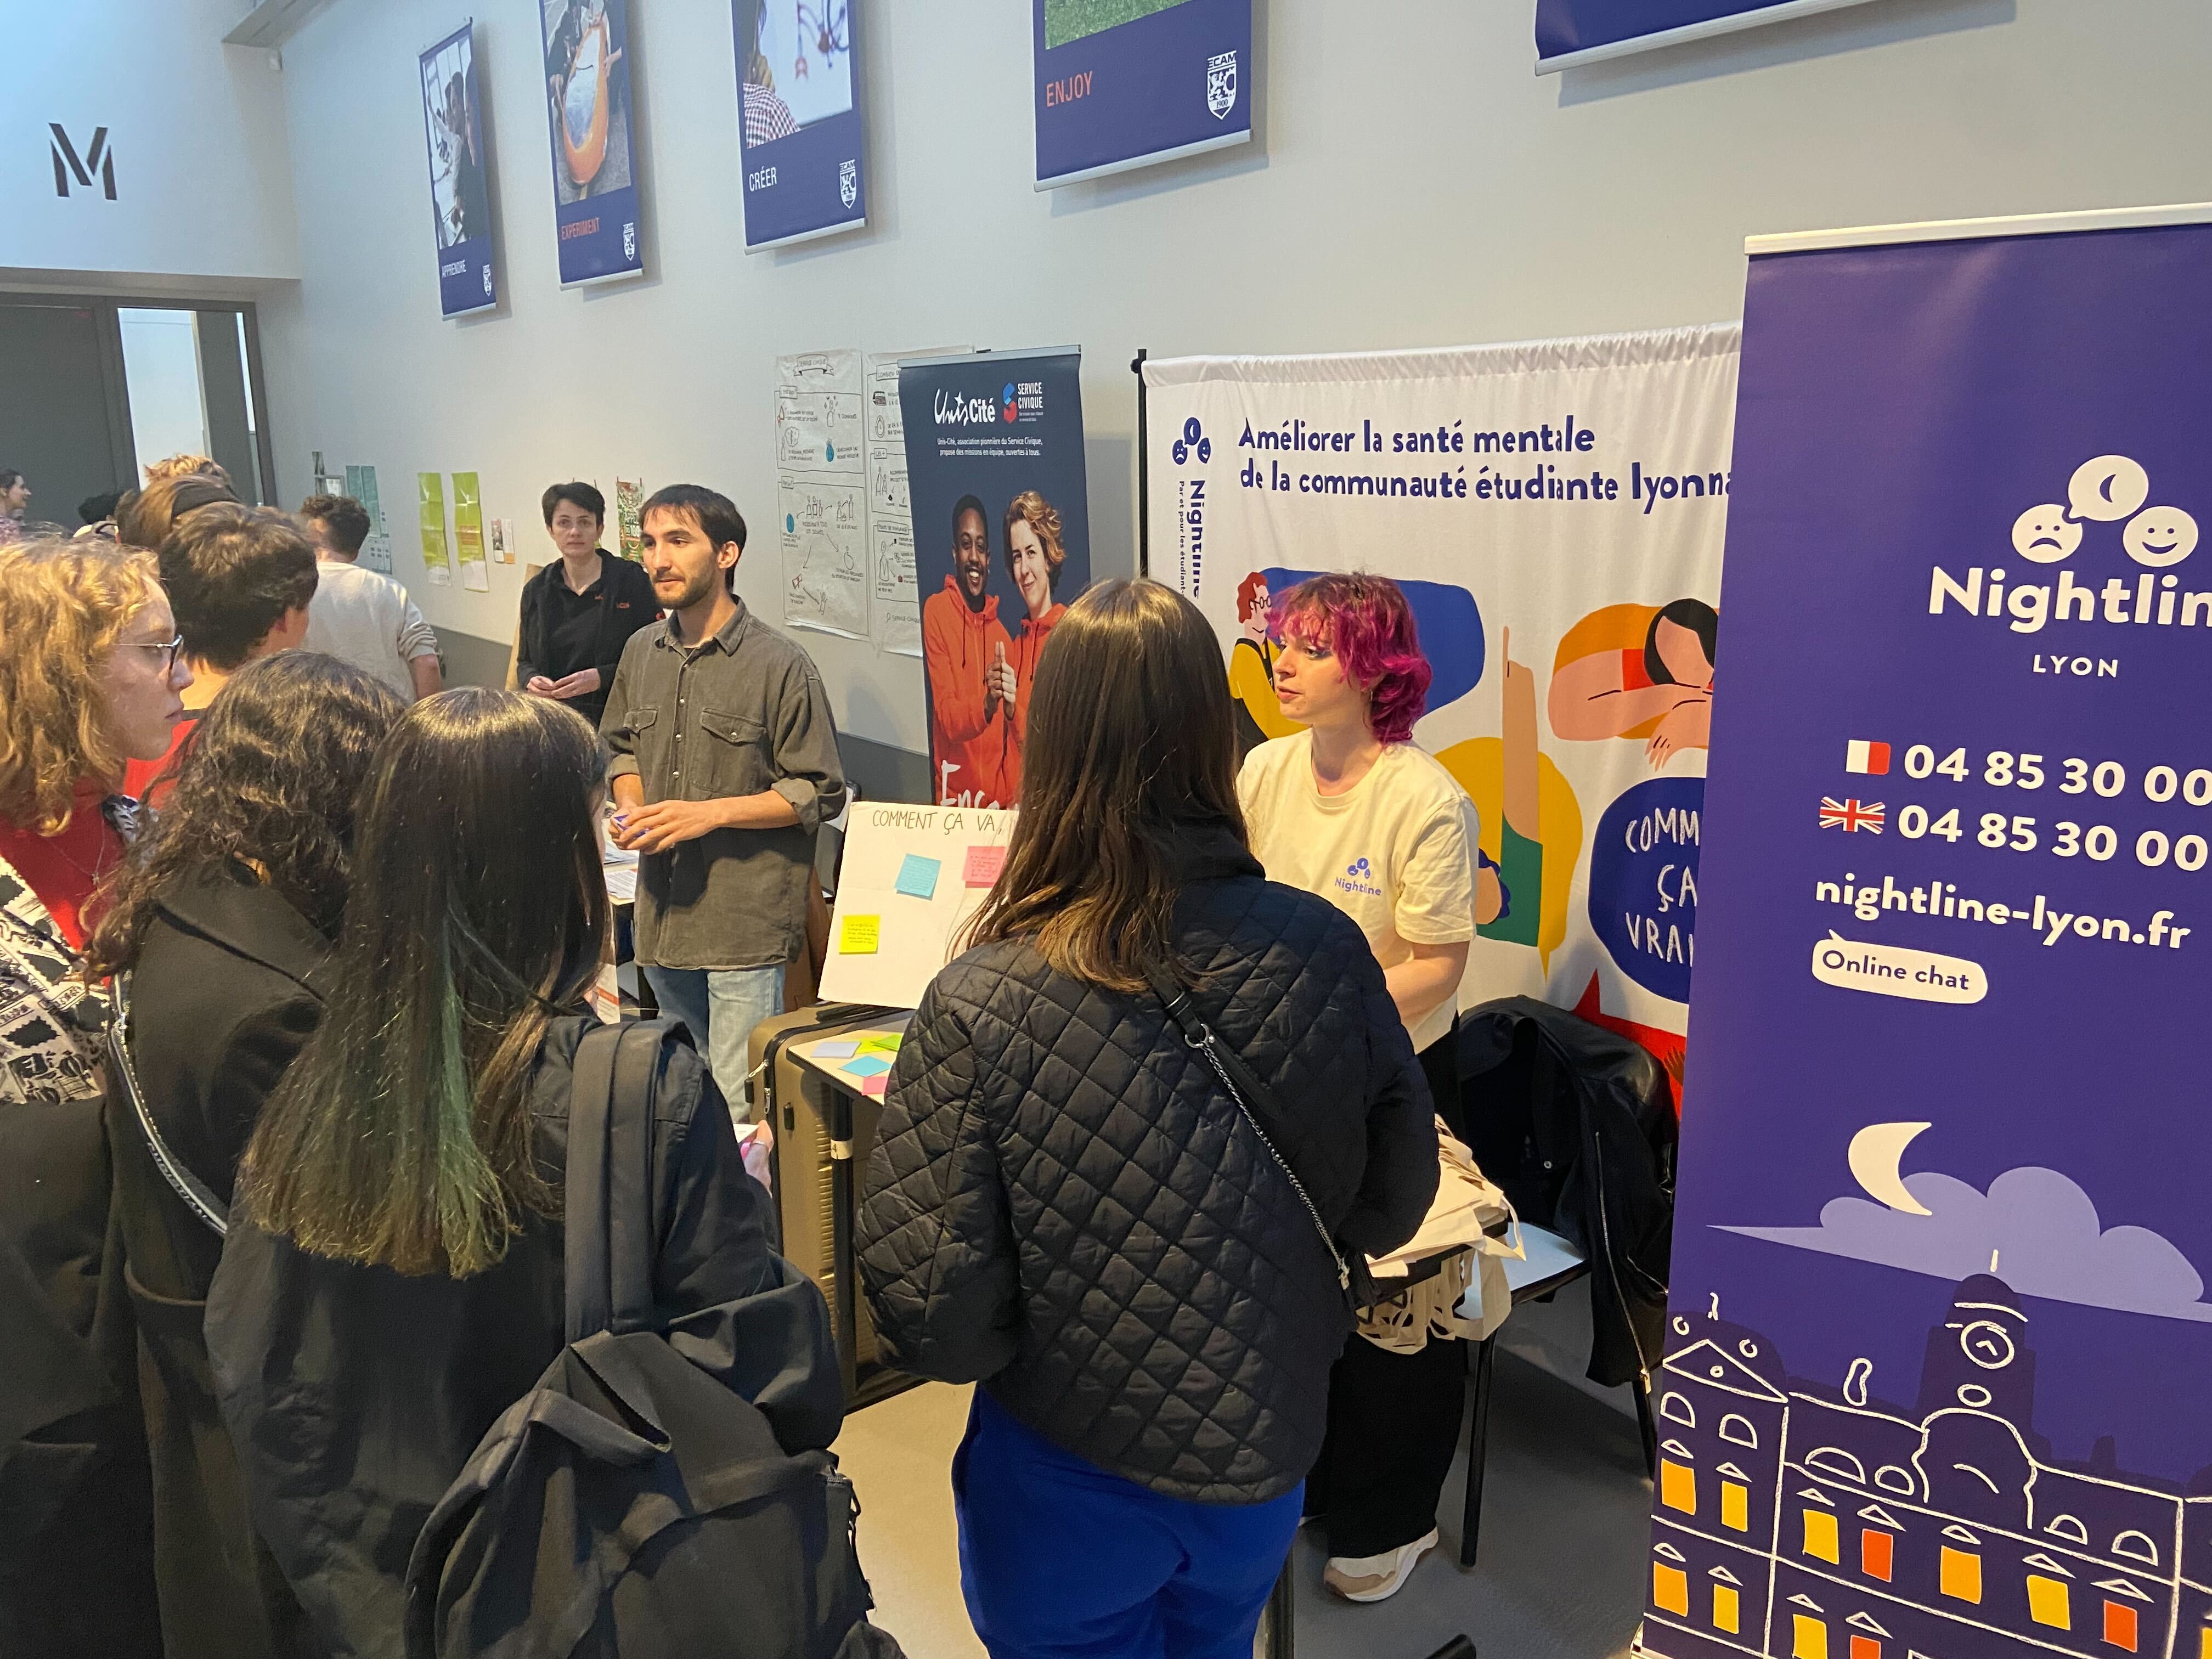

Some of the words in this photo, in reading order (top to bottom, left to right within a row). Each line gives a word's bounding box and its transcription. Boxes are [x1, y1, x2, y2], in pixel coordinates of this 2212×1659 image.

[1207, 53, 1236, 69] ECAM
[1046, 71, 1093, 107] ENJOY
[1216, 99, 1228, 109] 1900
[49, 122, 117, 200] M
[839, 161, 855, 171] ECAM
[749, 166, 777, 192] CRÉER
[561, 217, 600, 240] EXPERIMENT
[1017, 382, 1042, 395] SERVICE
[1018, 396, 1043, 409] CIVIQUE
[1238, 417, 1355, 452] Améliorer
[1363, 420, 1383, 452] la
[1392, 419, 1464, 453] santé
[1474, 415, 1595, 453] mentale
[1240, 458, 1263, 488] de
[1272, 460, 1290, 491] la
[1299, 465, 1467, 498] communauté
[1475, 464, 1618, 500] étudiante
[1180, 498, 1184, 509] et
[2033, 654, 2118, 678] LYON
[1904, 744, 1970, 782] 04
[1984, 751, 2045, 790] 85
[2058, 758, 2125, 798] 30
[2143, 765, 2212, 806] 00
[872, 810, 938, 830] COMMENT
[944, 813, 963, 835] ÇA
[977, 814, 1003, 835] VA,
[1898, 805, 1963, 843] 04
[1977, 812, 2038, 852] 85
[2051, 821, 2118, 861] 30
[2135, 830, 2209, 871] 00
[1334, 877, 1381, 895] Nightline
[1657, 864, 1697, 912] ÇA
[1815, 872, 2191, 949] nightline-lyon.fr
[1822, 949, 1907, 980] Online
[1915, 964, 1970, 990] chat
